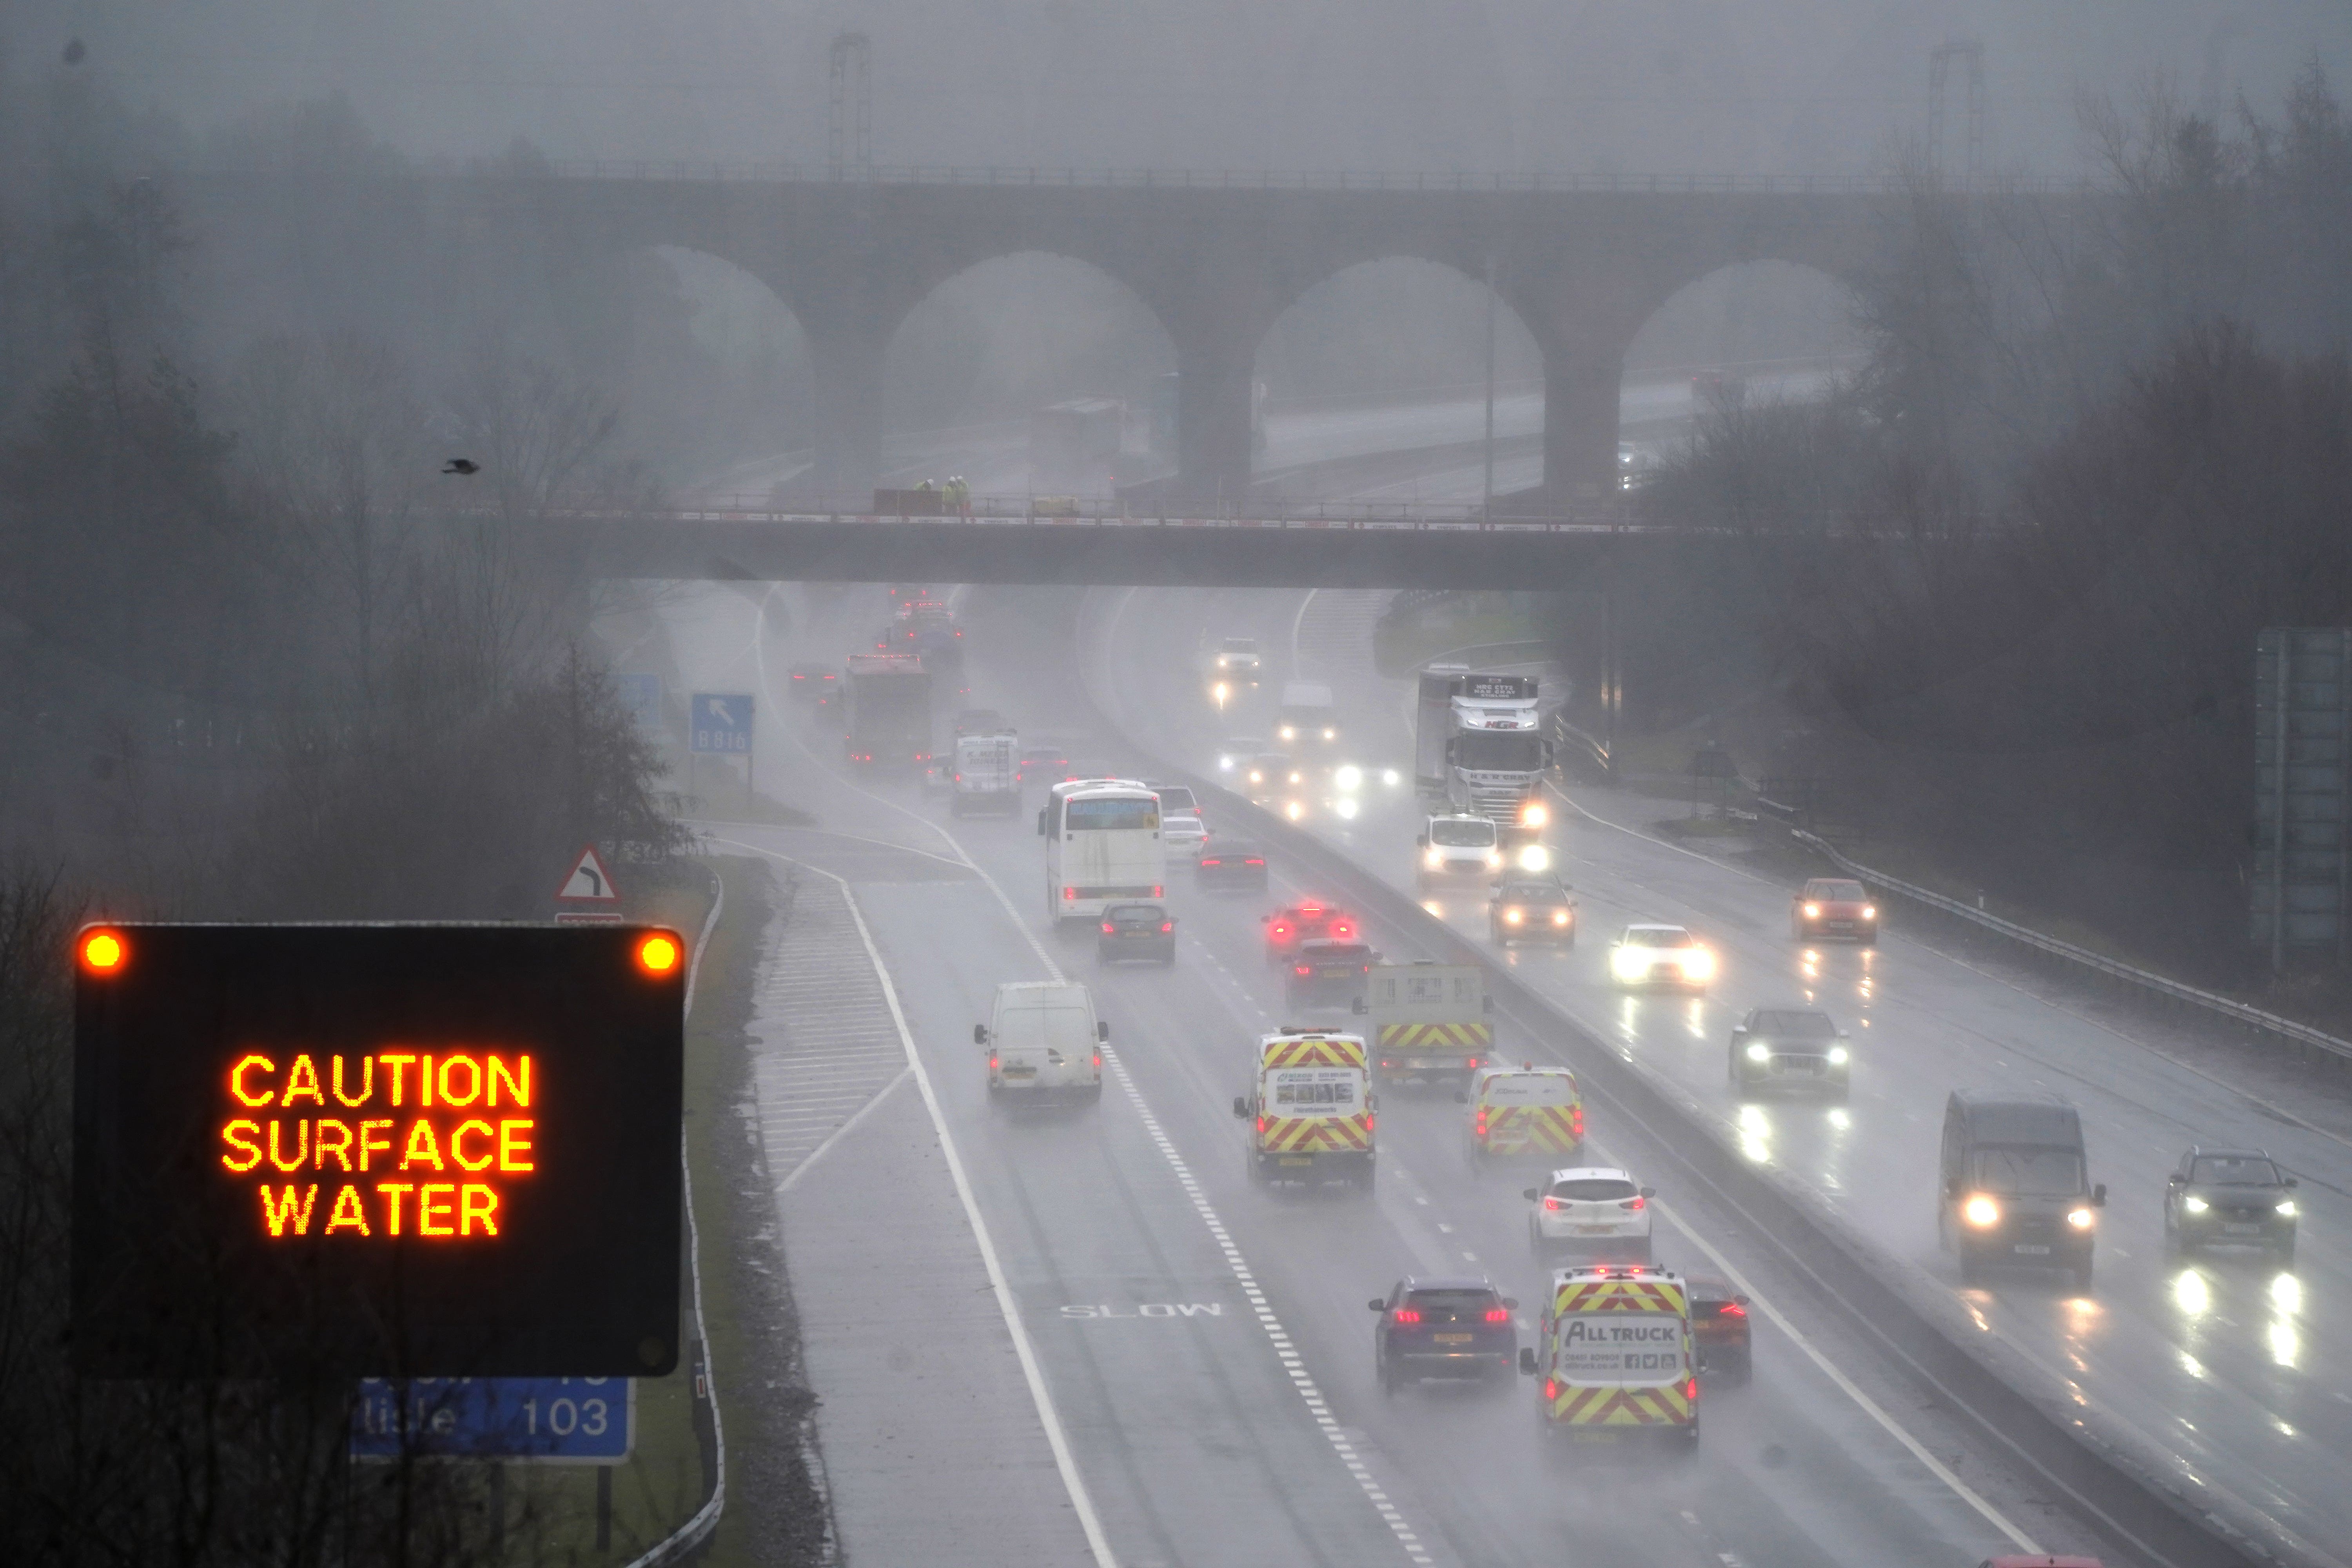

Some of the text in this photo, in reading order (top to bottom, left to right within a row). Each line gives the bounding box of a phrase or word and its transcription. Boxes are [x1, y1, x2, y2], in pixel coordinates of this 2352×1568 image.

[231, 1054, 530, 1107] CAUTION
[221, 1119, 534, 1171] SURFACE
[260, 1183, 498, 1237] WATER
[1060, 1303, 1222, 1318] SLOW
[523, 1398, 608, 1436] 103
